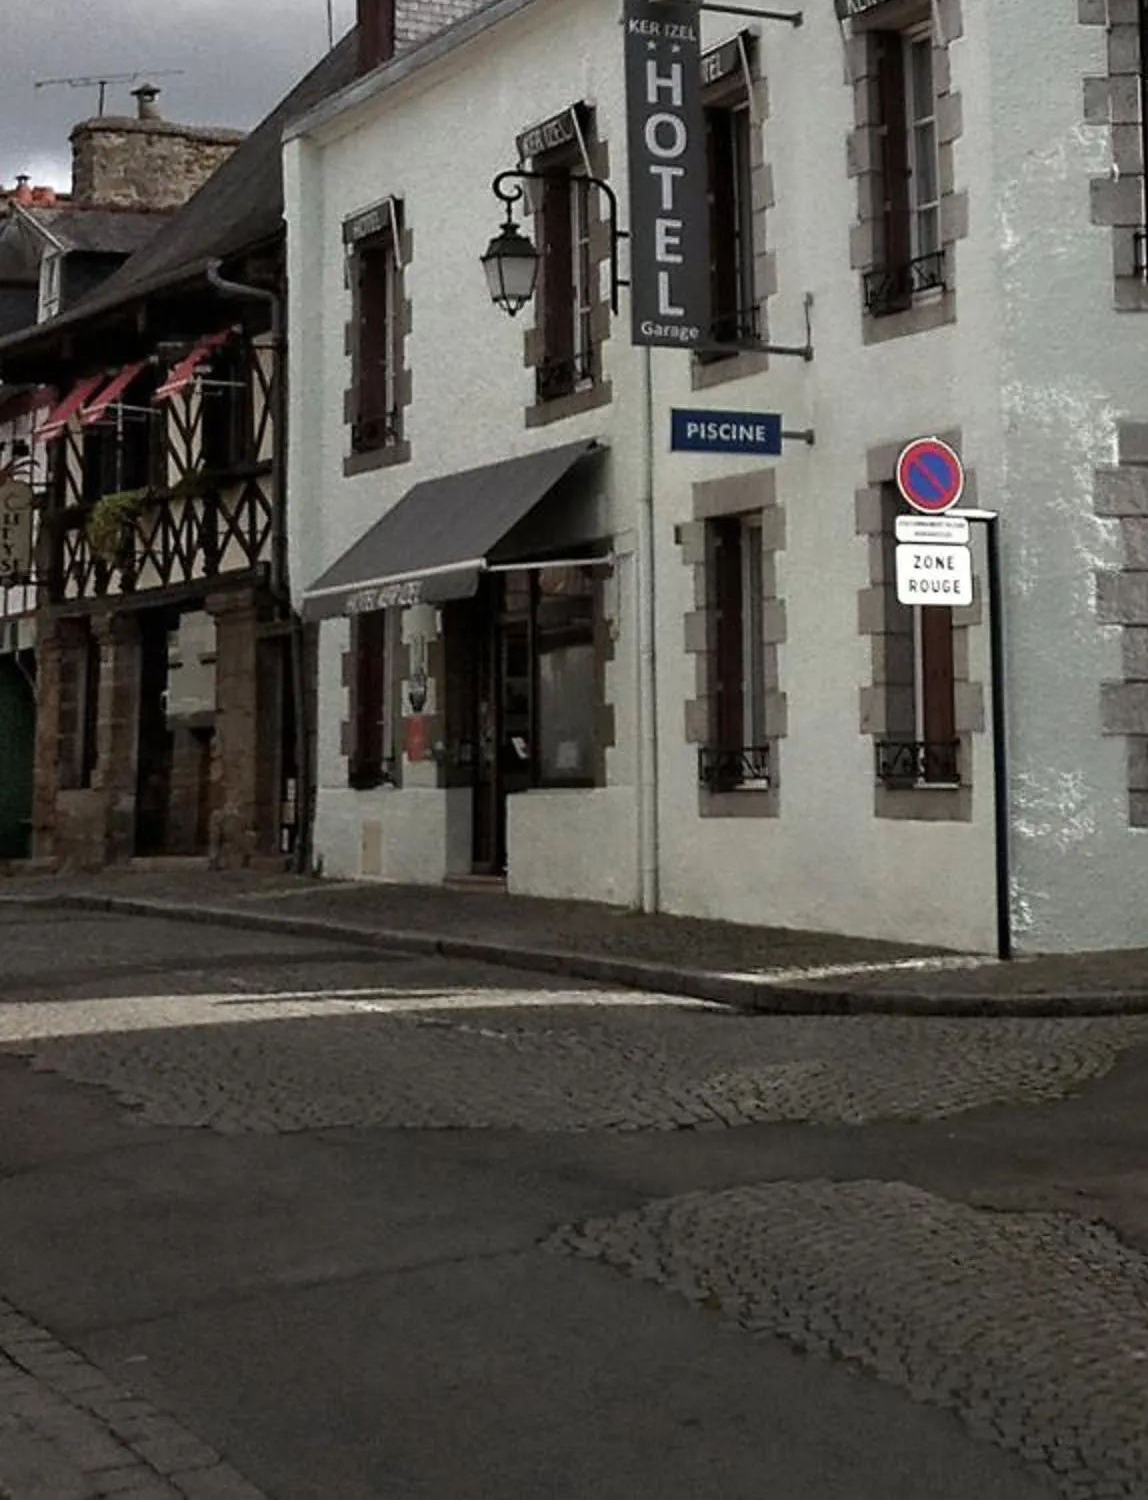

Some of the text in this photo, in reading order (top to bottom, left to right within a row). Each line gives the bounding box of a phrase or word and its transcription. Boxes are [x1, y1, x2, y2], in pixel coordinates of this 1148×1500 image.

[629, 18, 697, 41] KER IZEL
[701, 52, 724, 85] TEL
[644, 59, 687, 316] HOTEL
[640, 320, 700, 342] Garage
[686, 421, 767, 442] PISCINE
[913, 555, 955, 571] ZONE
[908, 579, 961, 595] ROUGE
